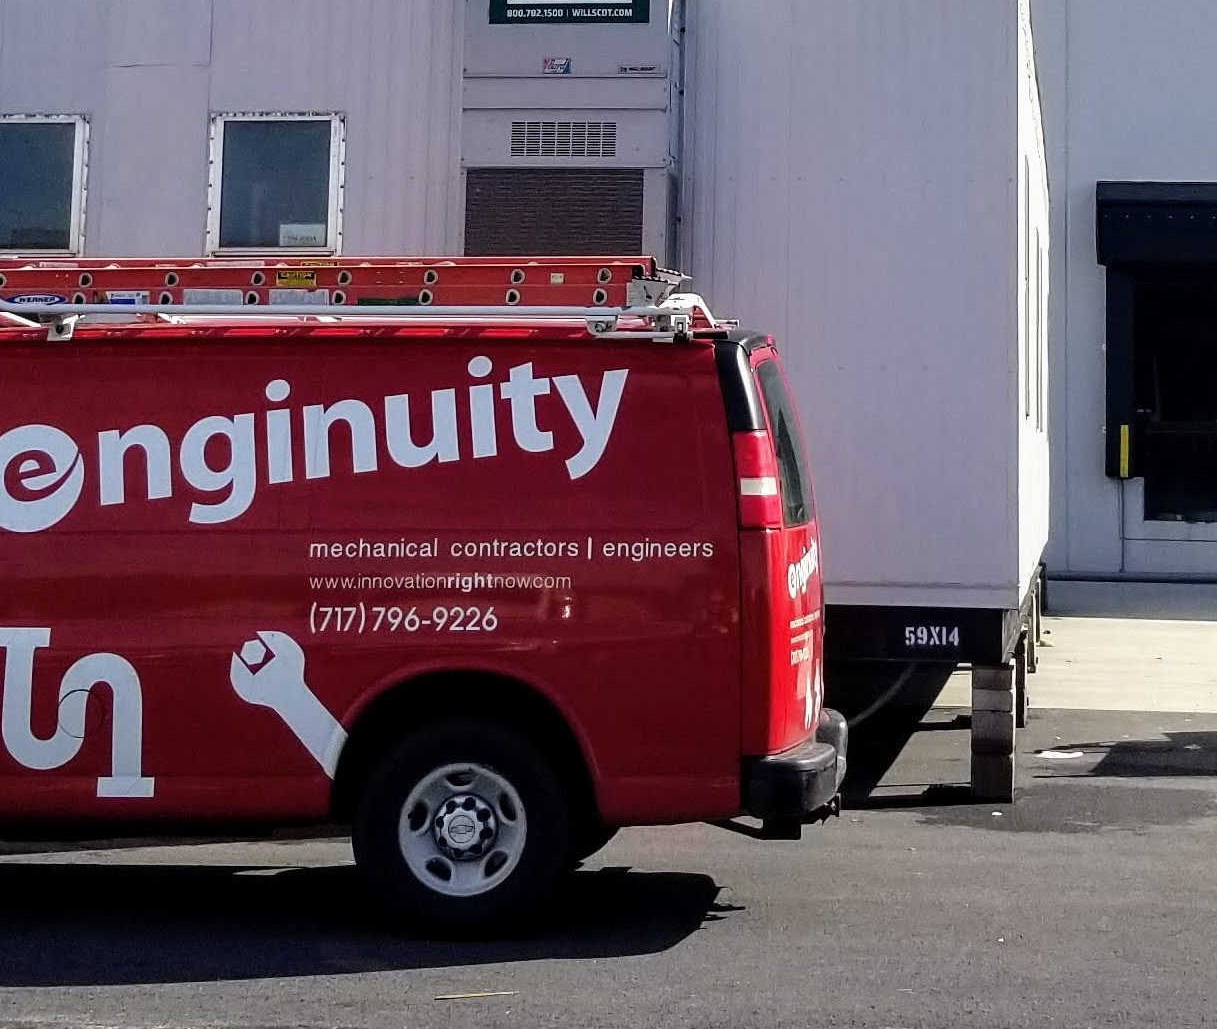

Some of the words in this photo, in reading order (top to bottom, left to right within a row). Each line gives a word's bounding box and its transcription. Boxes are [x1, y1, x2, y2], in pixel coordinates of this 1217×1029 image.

[571, 8, 633, 17] WILLSCOT.COM
[309, 538, 438, 558] mechanical
[450, 538, 579, 558] contractors
[602, 538, 714, 562] engineers
[309, 572, 572, 593] www.innovationrightnow.com
[309, 601, 366, 634] (717)
[372, 606, 498, 632] 796-9226
